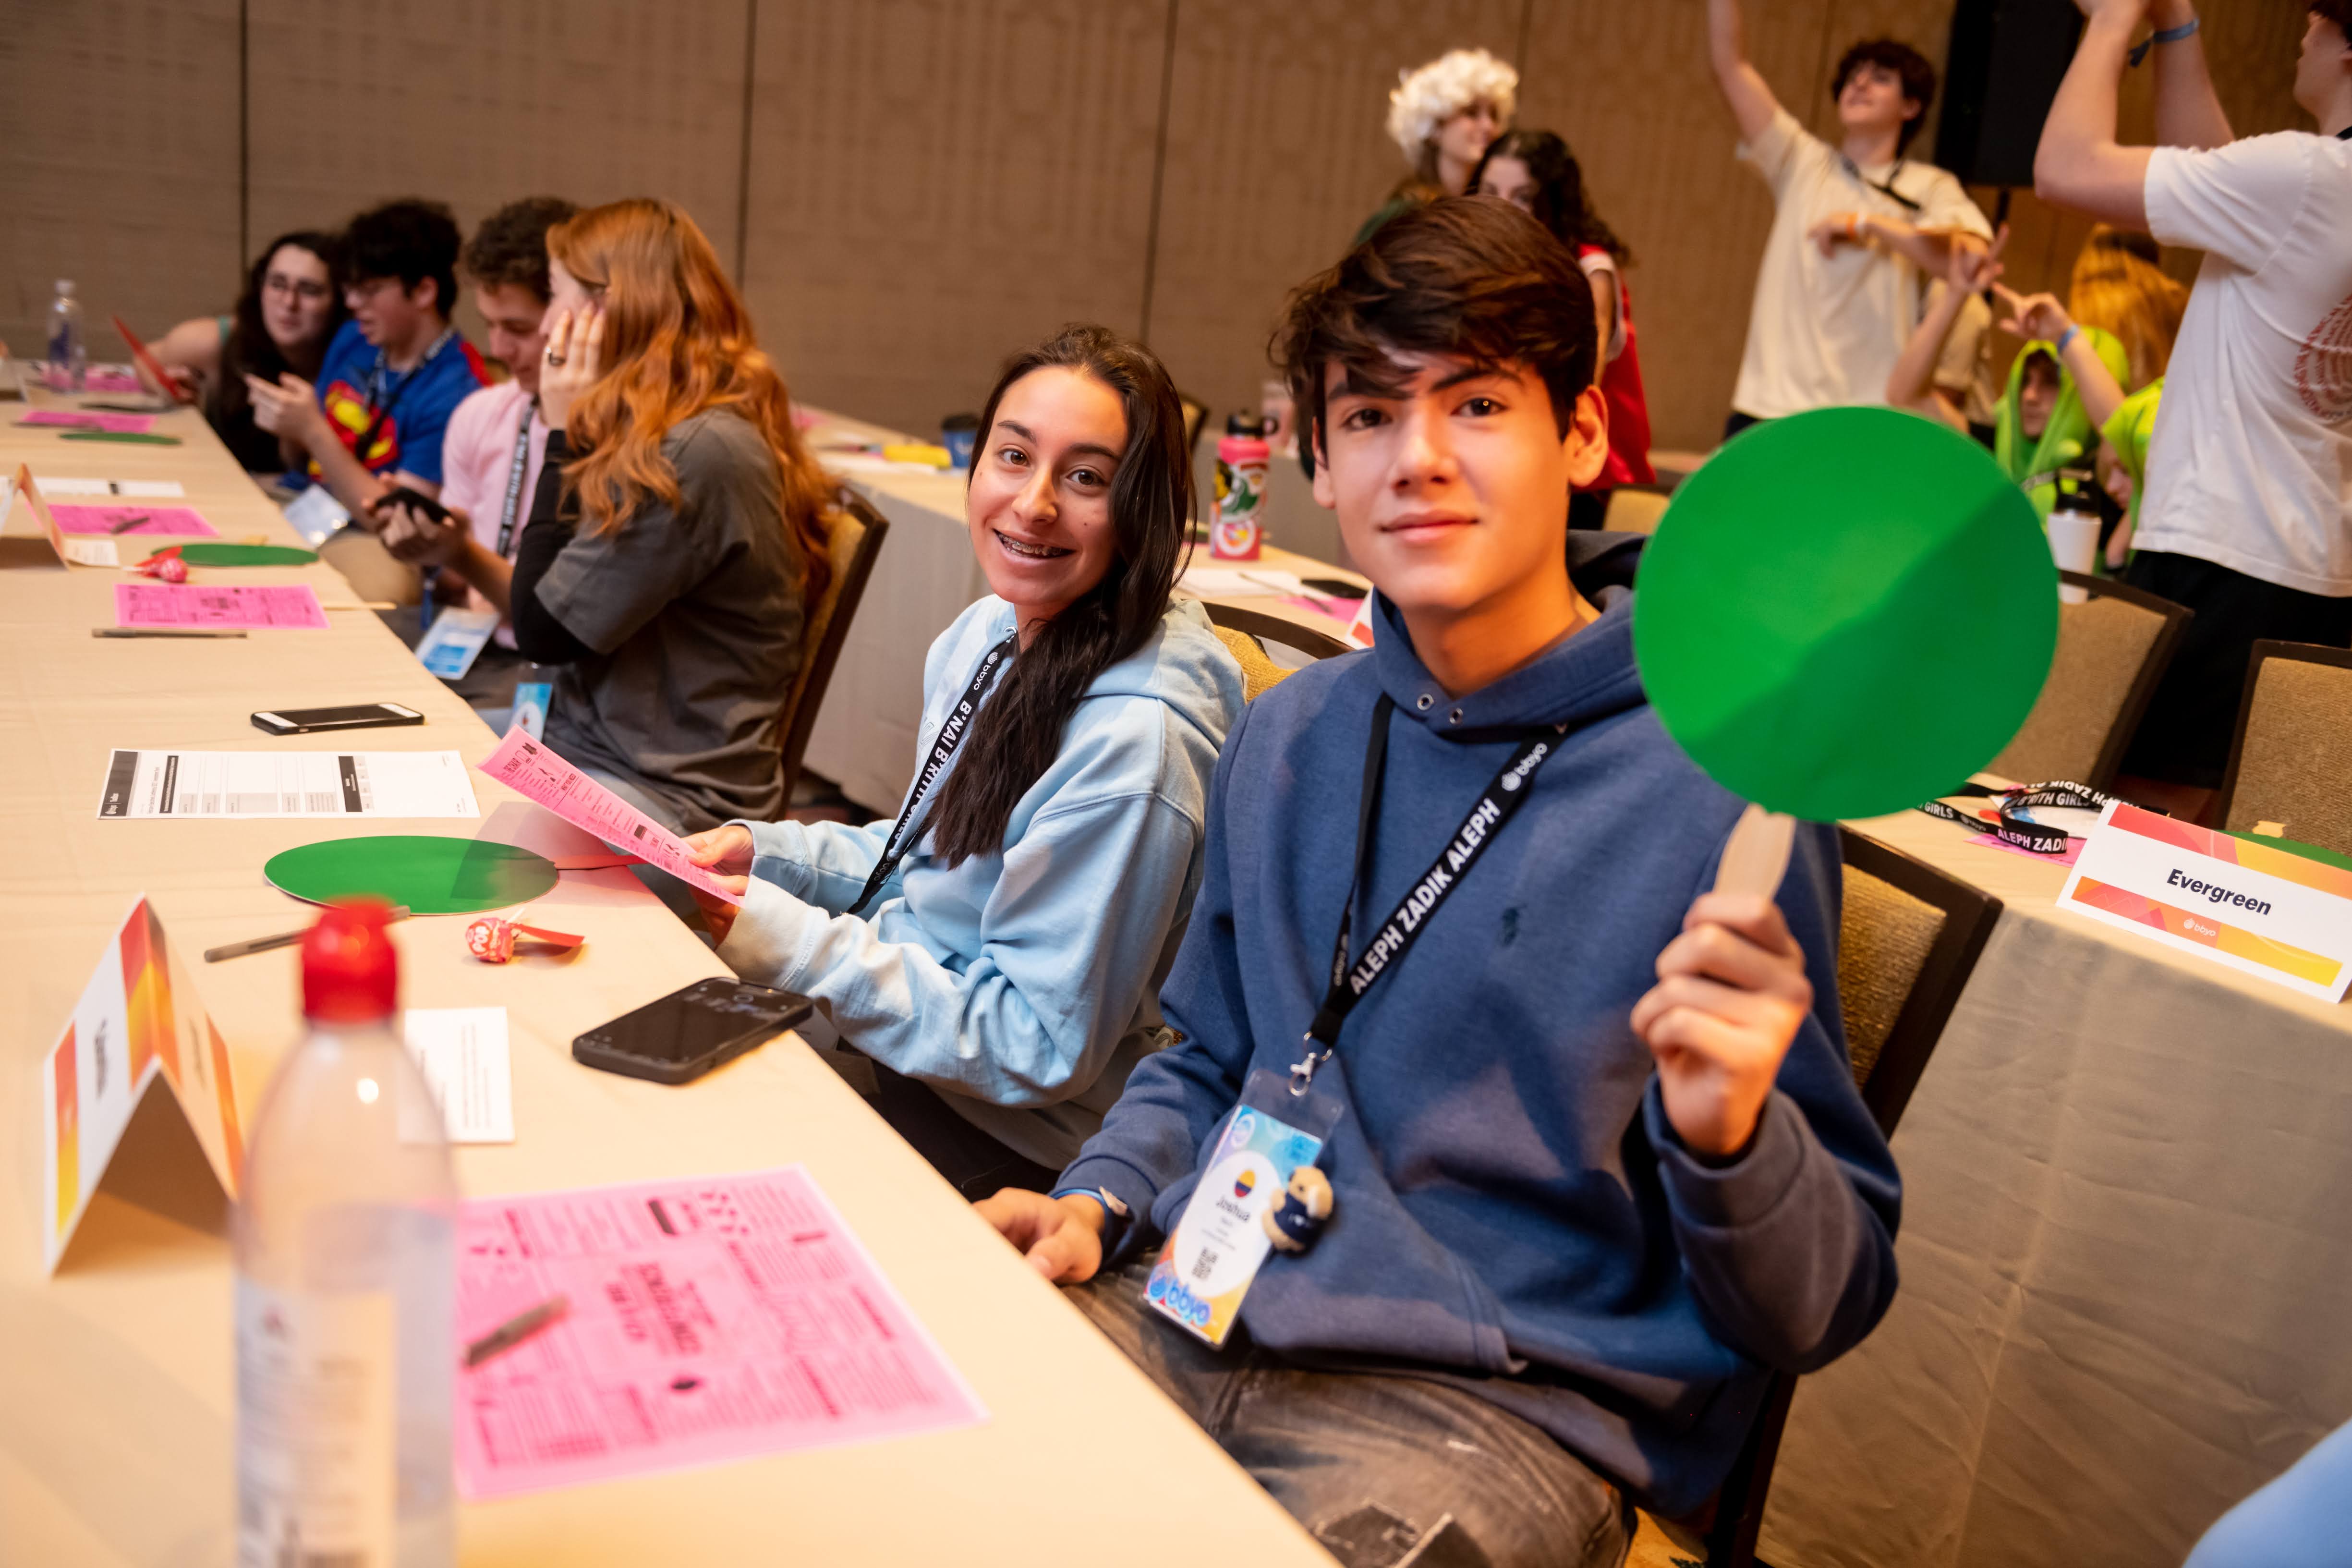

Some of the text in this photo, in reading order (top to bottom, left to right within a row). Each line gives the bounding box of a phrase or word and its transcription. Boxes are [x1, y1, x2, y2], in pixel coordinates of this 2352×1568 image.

[974, 665, 991, 690] bbyo
[941, 700, 972, 748] B'NAI
[2049, 780, 2092, 799] ZADIK
[1924, 802, 1954, 819] GIRLS
[1998, 828, 2031, 849] ALEPH
[1350, 743, 1547, 995] ALEPH ZADIK ALEPH bbyo
[2166, 868, 2271, 915] Evergreen
[2194, 923, 2216, 937] bbyo
[1168, 1278, 1210, 1325] bbyo
